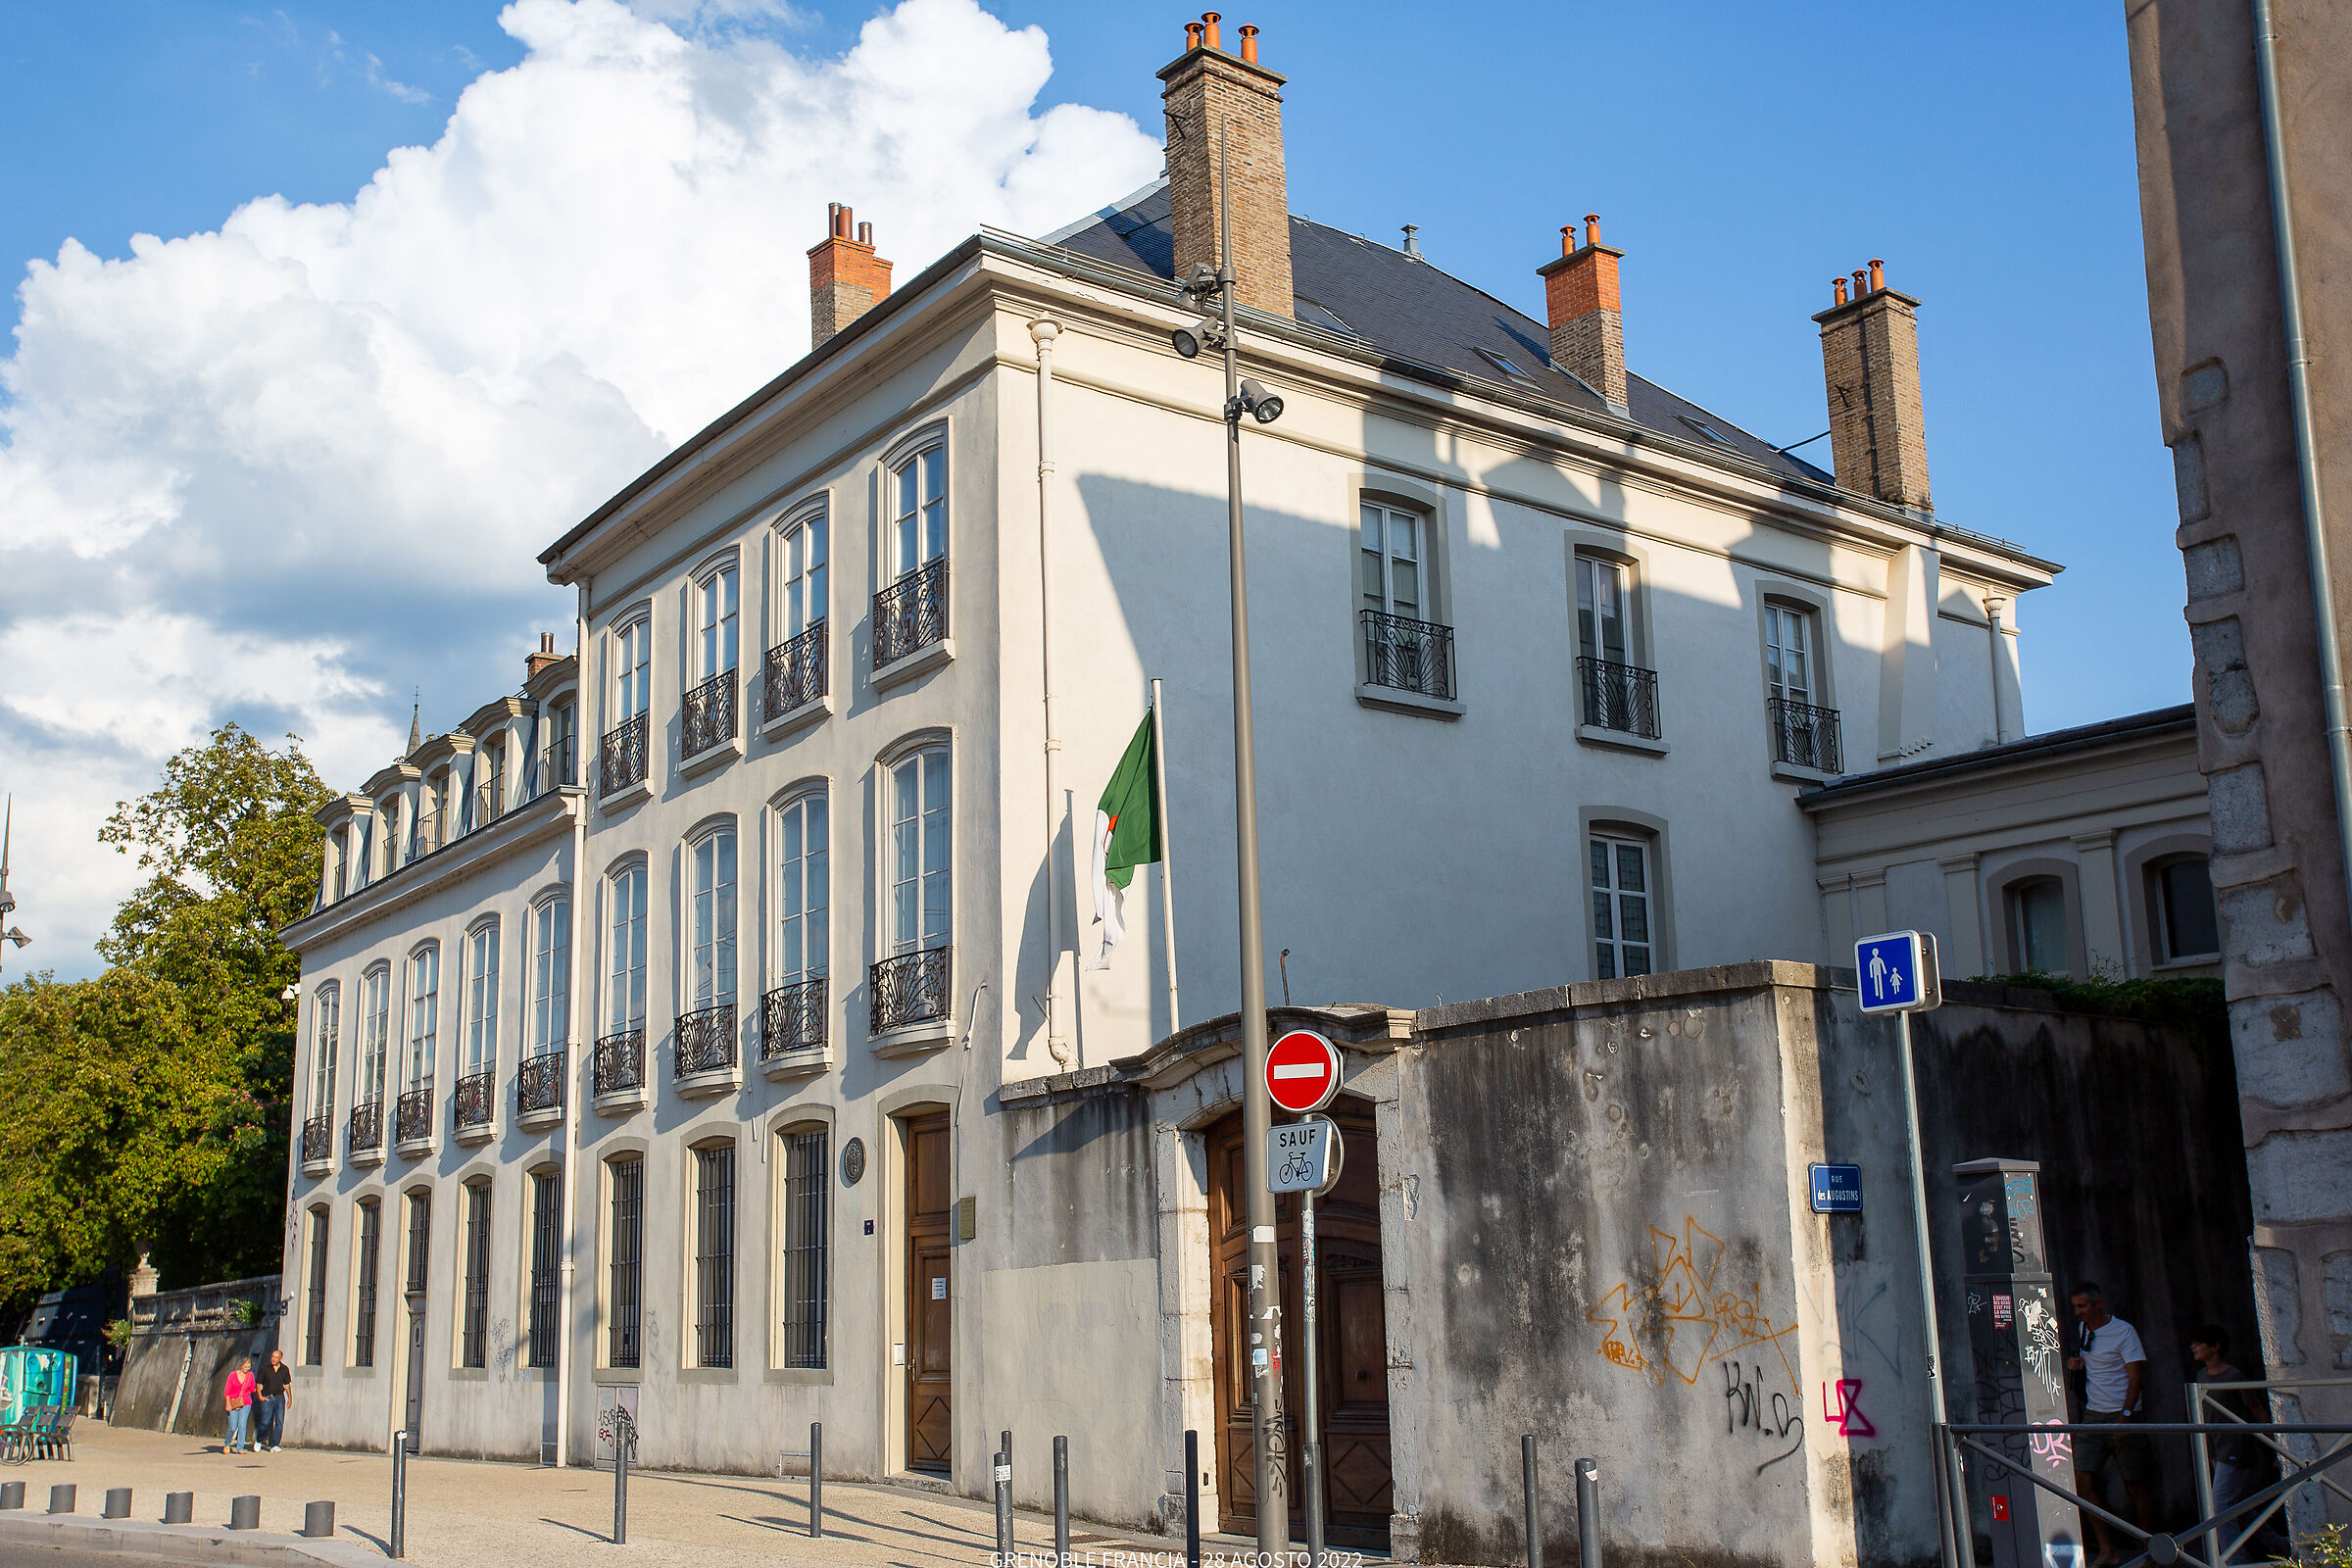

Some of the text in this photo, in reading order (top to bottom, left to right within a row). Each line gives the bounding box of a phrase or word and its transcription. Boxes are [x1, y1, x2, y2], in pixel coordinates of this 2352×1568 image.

[1279, 1129, 1315, 1148] SAUF
[1817, 1189, 1858, 1200] des AUGUSTINS
